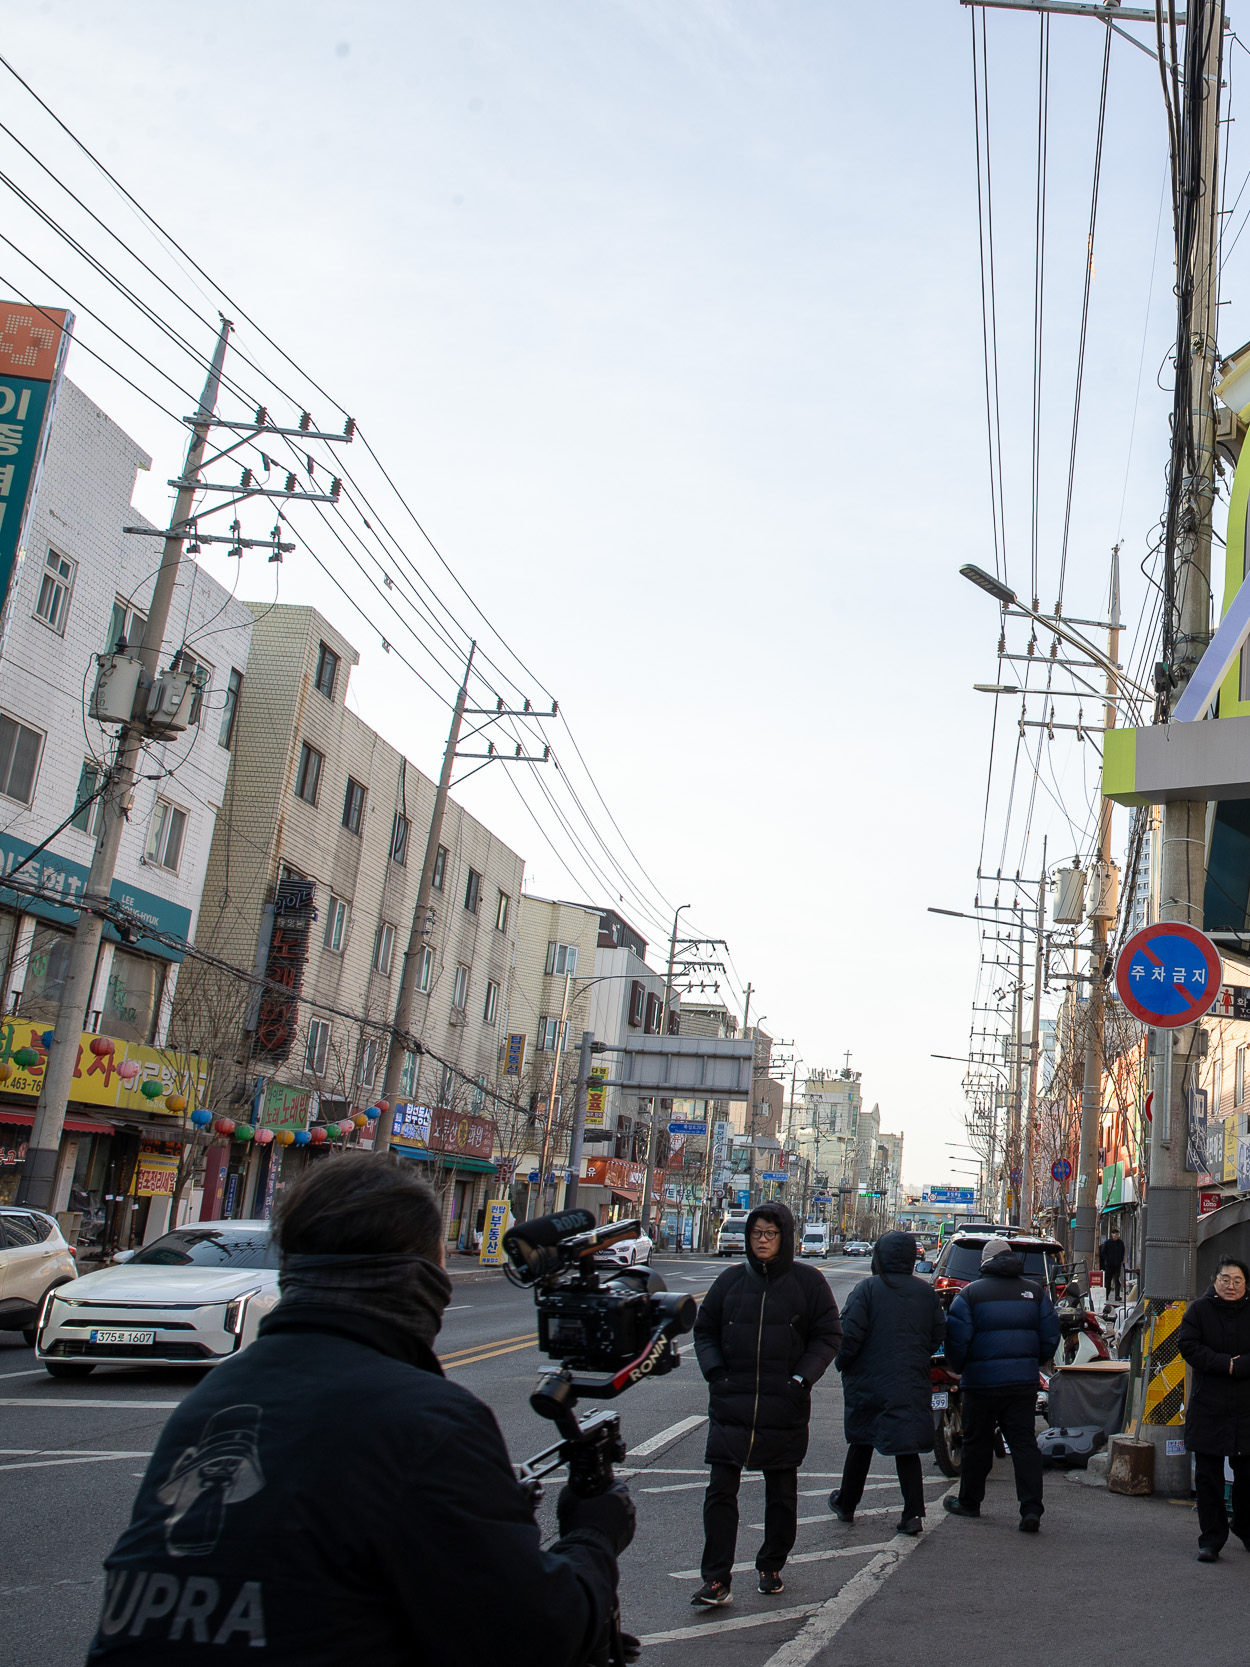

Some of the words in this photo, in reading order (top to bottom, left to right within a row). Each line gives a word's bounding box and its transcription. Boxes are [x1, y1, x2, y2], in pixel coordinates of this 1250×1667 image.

[121, 894, 135, 906] LEE
[1131, 964, 1206, 984] 주차금지
[485, 1214, 502, 1255] 부동산
[128, 1332, 152, 1343] 1607
[629, 1333, 669, 1382] RONIN
[98, 1568, 268, 1647] UPRA
